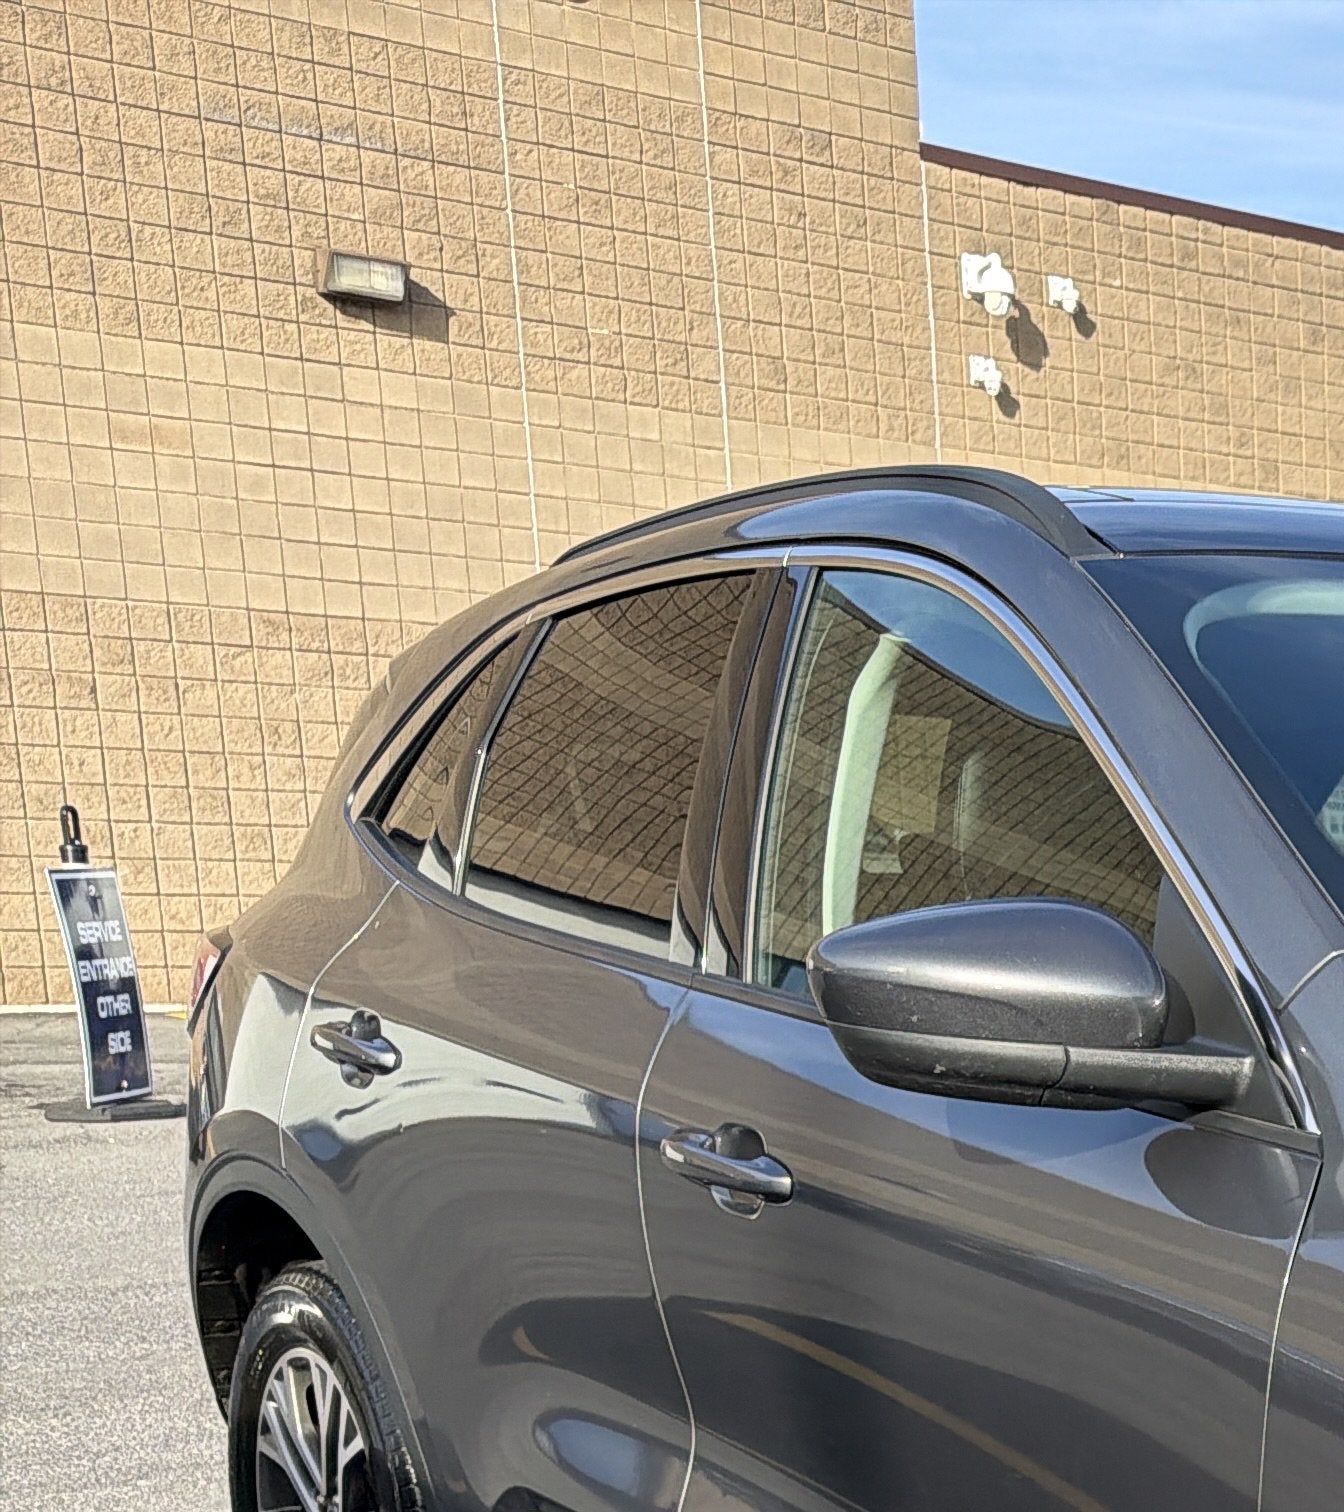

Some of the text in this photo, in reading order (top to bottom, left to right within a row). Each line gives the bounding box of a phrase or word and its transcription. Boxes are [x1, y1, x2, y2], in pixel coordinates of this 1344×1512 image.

[77, 921, 122, 944] SERVICE
[78, 957, 134, 982] ENTRANCE
[97, 994, 132, 1018] OTHER
[108, 1031, 132, 1054] SIDE
